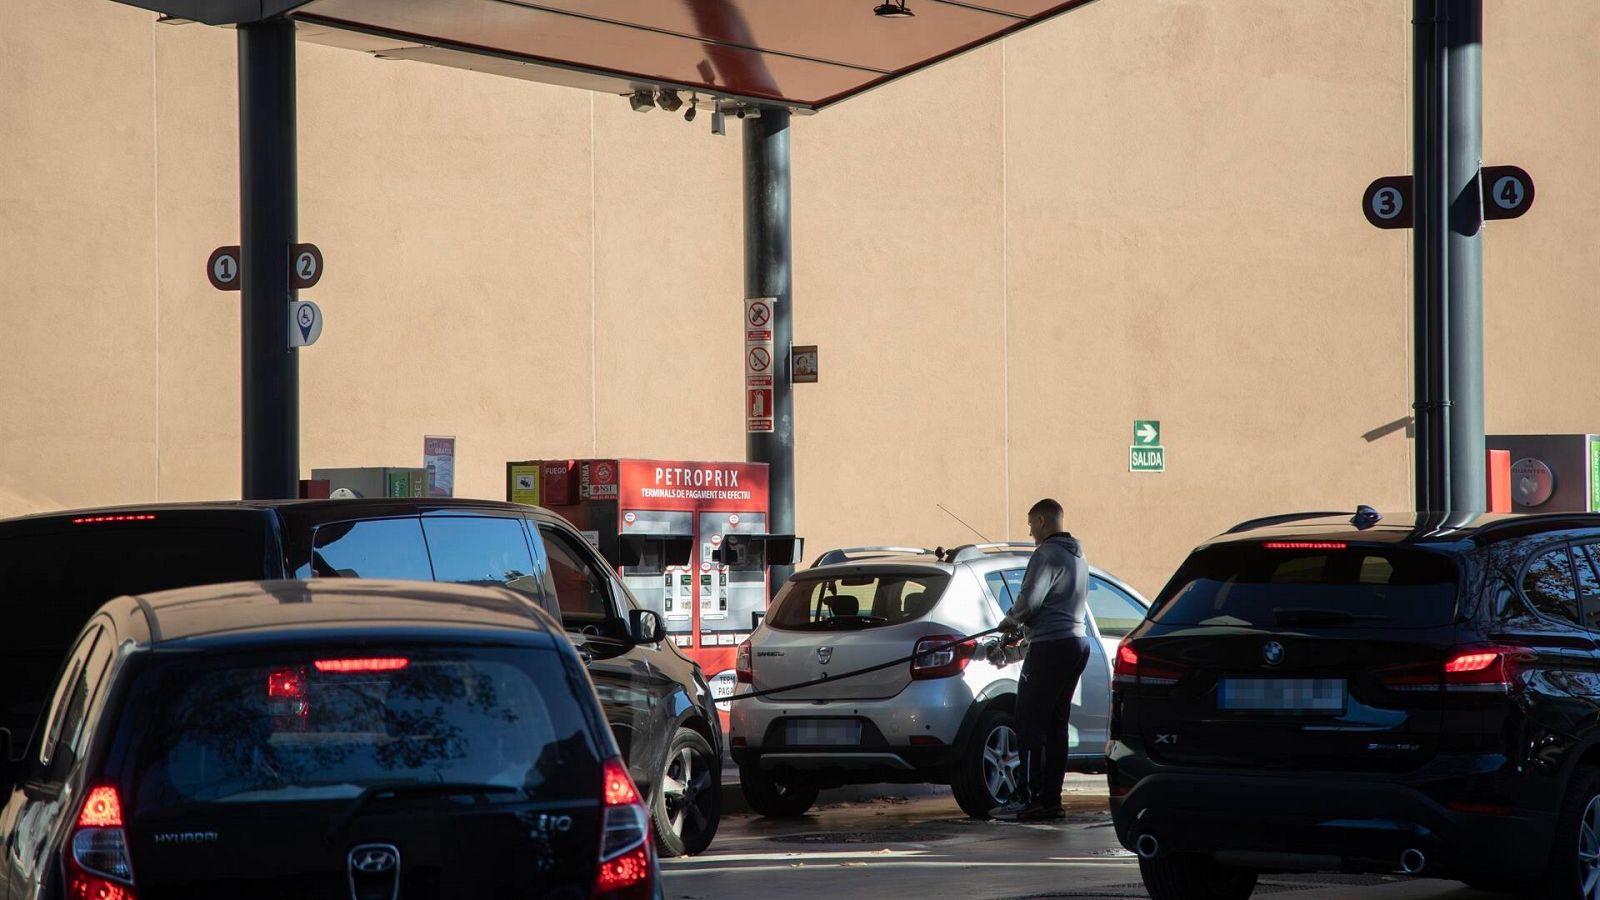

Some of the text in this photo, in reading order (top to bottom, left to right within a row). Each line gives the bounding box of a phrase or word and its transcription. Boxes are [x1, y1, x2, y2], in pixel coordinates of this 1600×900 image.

[1379, 190, 1396, 215] 3
[1500, 180, 1518, 204] 4
[220, 258, 232, 279] 1
[301, 255, 312, 276] 2
[1132, 451, 1162, 466] SALIDA
[545, 467, 567, 475] FUEGO
[582, 464, 590, 498] ALARMA
[655, 467, 739, 488] PETROPRIX
[641, 488, 676, 499] TERMINALS
[676, 489, 685, 499] DE
[685, 490, 718, 500] PAGAMENT
[718, 490, 727, 500] EN
[1154, 733, 1177, 744] X1
[154, 832, 218, 844] HYUNDAI
